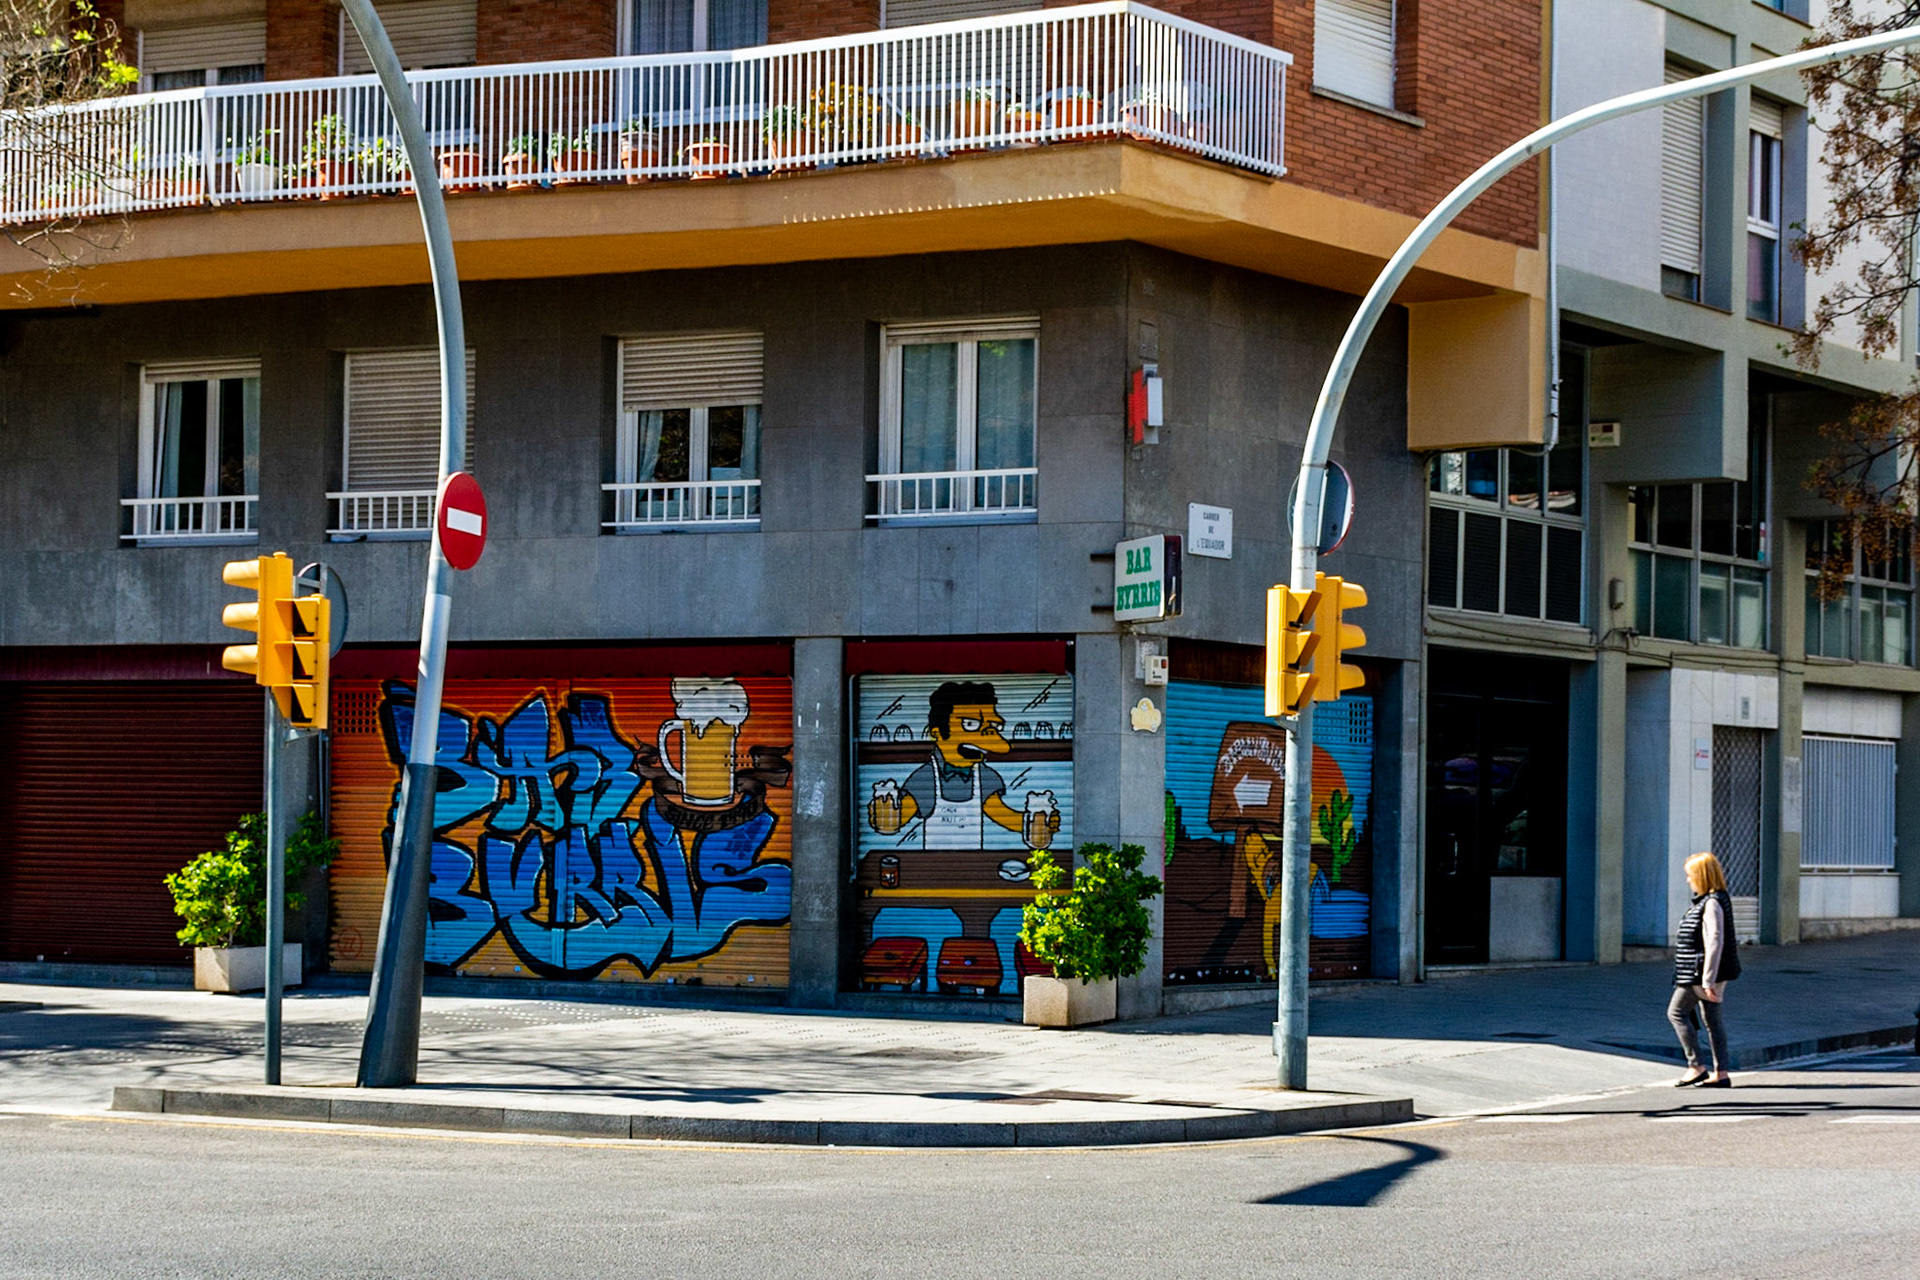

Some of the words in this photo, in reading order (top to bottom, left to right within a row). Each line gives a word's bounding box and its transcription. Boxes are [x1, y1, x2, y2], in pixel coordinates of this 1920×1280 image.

[1126, 546, 1152, 575] BAR
[1116, 580, 1161, 611] BYRRIS
[379, 681, 641, 834] BAR
